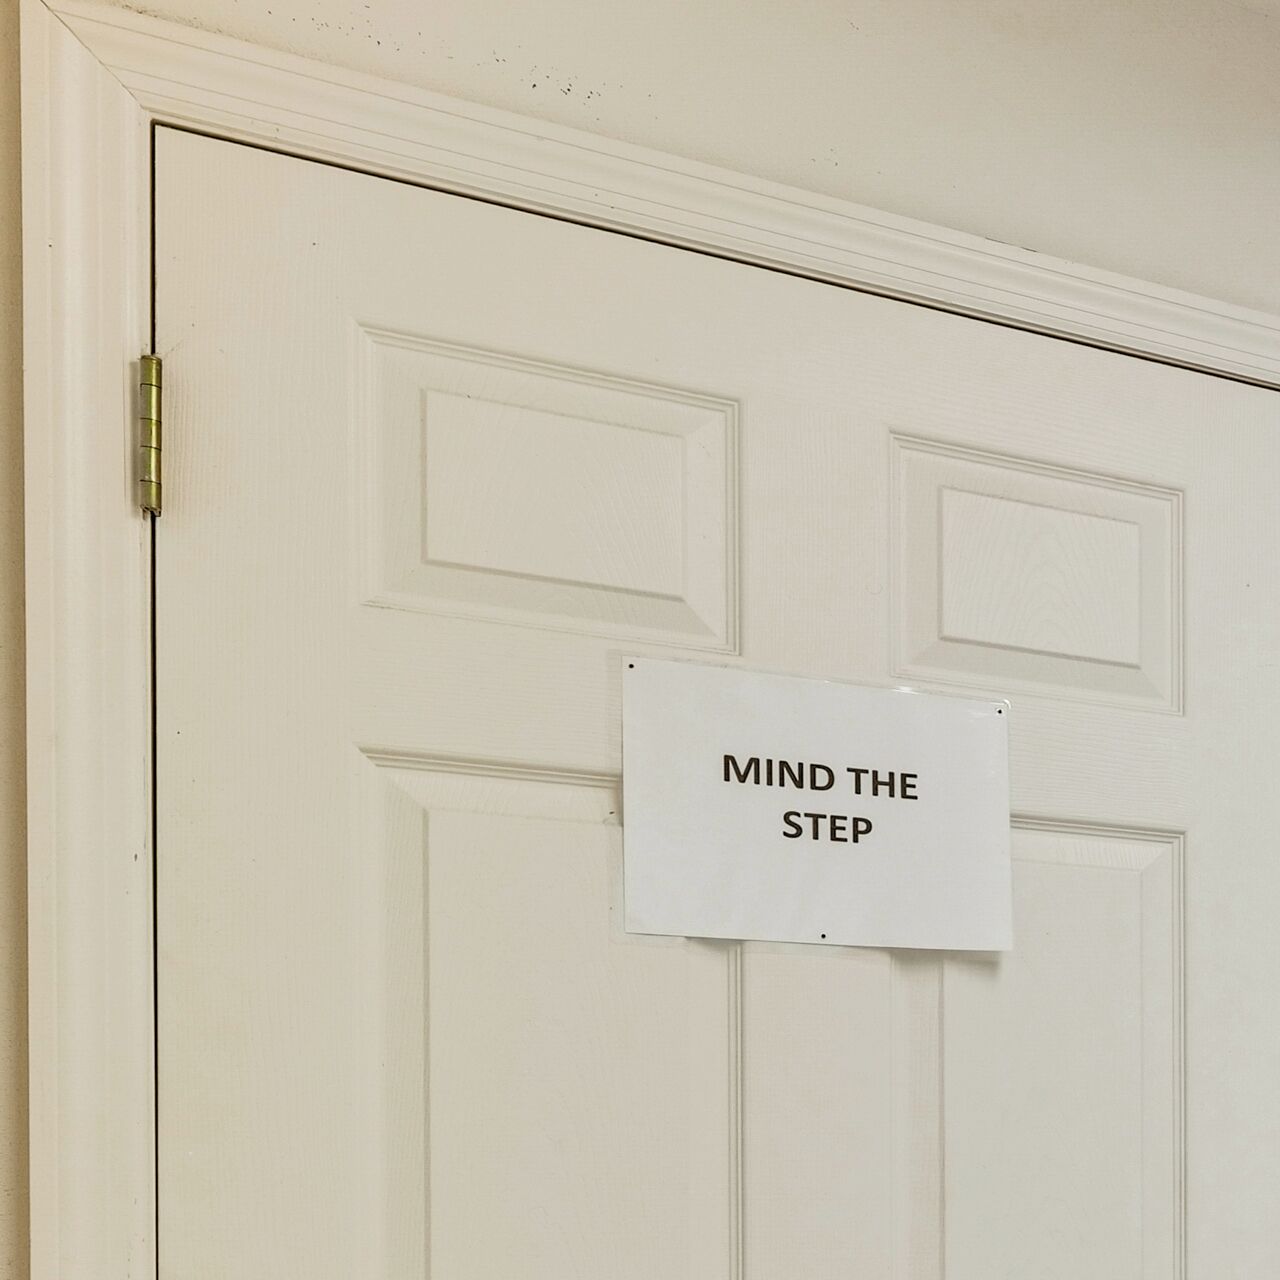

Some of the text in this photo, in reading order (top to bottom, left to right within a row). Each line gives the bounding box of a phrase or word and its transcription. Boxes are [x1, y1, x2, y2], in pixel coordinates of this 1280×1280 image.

[723, 754, 918, 800] MIND THE
[782, 811, 873, 844] STEP
